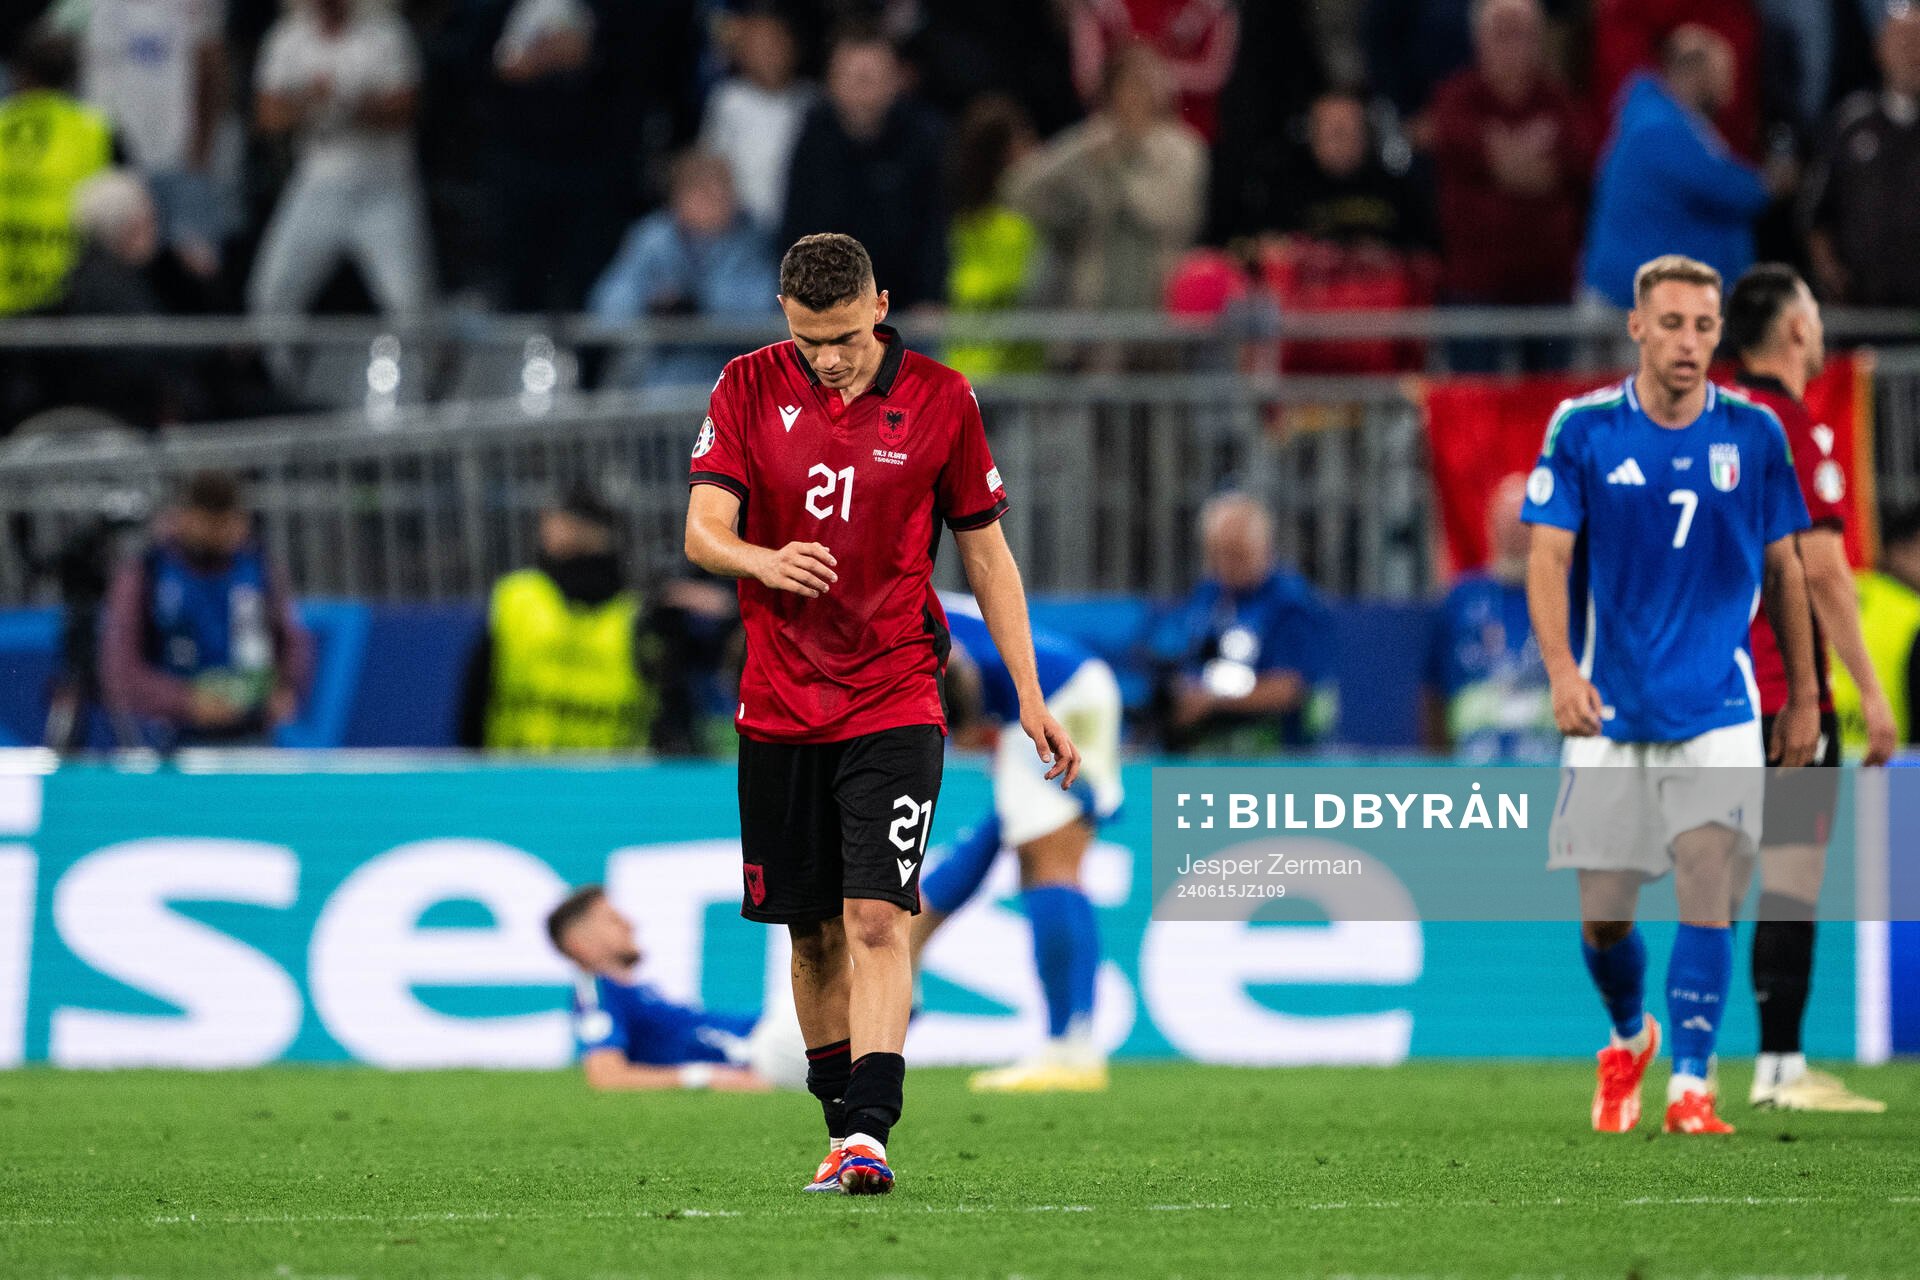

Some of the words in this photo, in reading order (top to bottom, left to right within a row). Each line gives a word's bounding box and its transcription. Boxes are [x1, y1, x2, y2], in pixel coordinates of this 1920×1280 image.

[805, 462, 855, 522] 21
[1668, 489, 1699, 549] 7
[888, 794, 933, 857] 21
